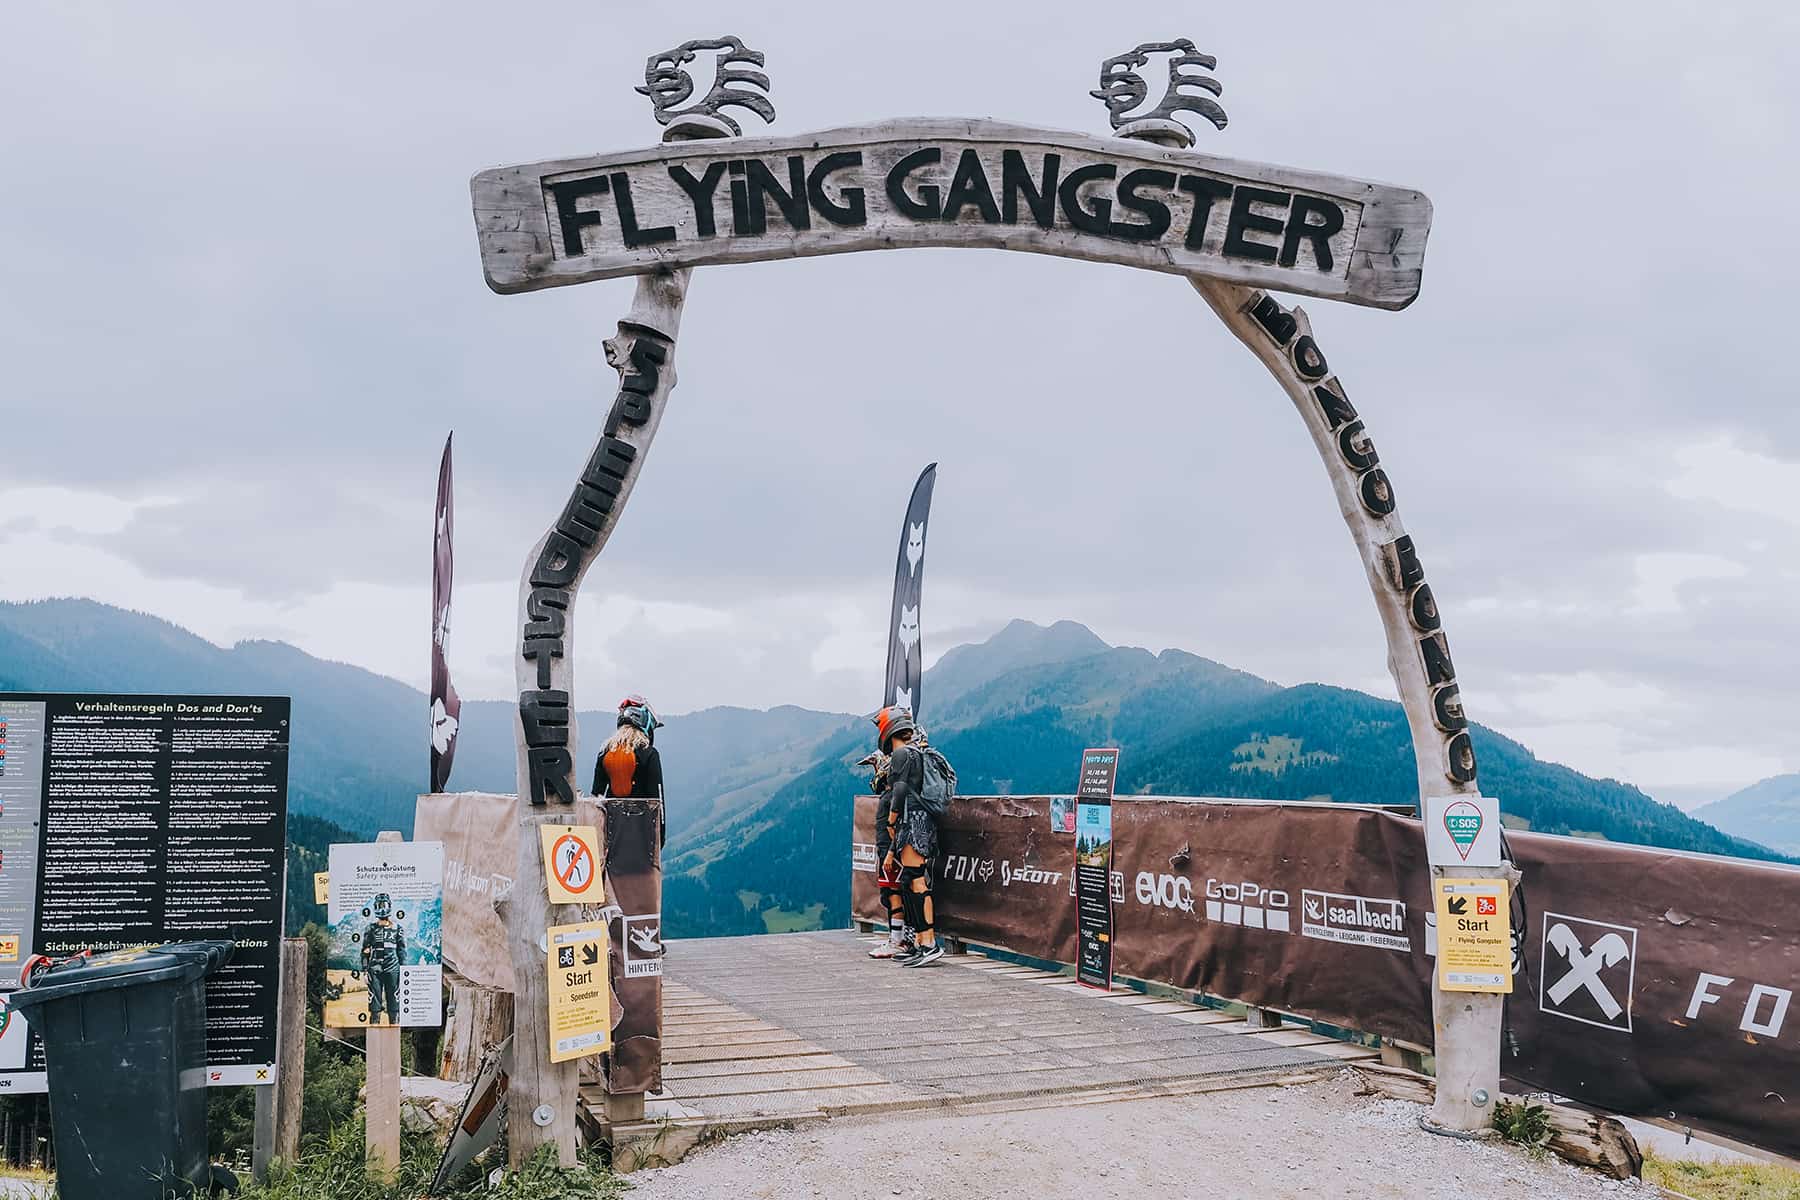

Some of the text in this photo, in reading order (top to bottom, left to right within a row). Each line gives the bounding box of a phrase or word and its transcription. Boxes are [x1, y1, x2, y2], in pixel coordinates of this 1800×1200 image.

[885, 147, 1345, 271] GANGSTER
[1251, 295, 1477, 782] BONGO BONGO
[519, 337, 668, 806] SPEEDSTER
[75, 702, 173, 714] Verhaltensregeln
[177, 703, 199, 713] Dos
[202, 703, 224, 713] and
[1458, 818, 1478, 828] SOS
[356, 865, 416, 873] Schutzausrüstung
[380, 872, 416, 880] equipment
[943, 855, 979, 882] FOX
[1011, 867, 1063, 885] SCOTT
[1206, 878, 1289, 908] GoPro
[1328, 898, 1403, 931] saalbach
[1457, 918, 1489, 931] Start
[1476, 937, 1502, 945] Gangster
[566, 969, 593, 987] Start
[570, 991, 599, 1003] Speedster
